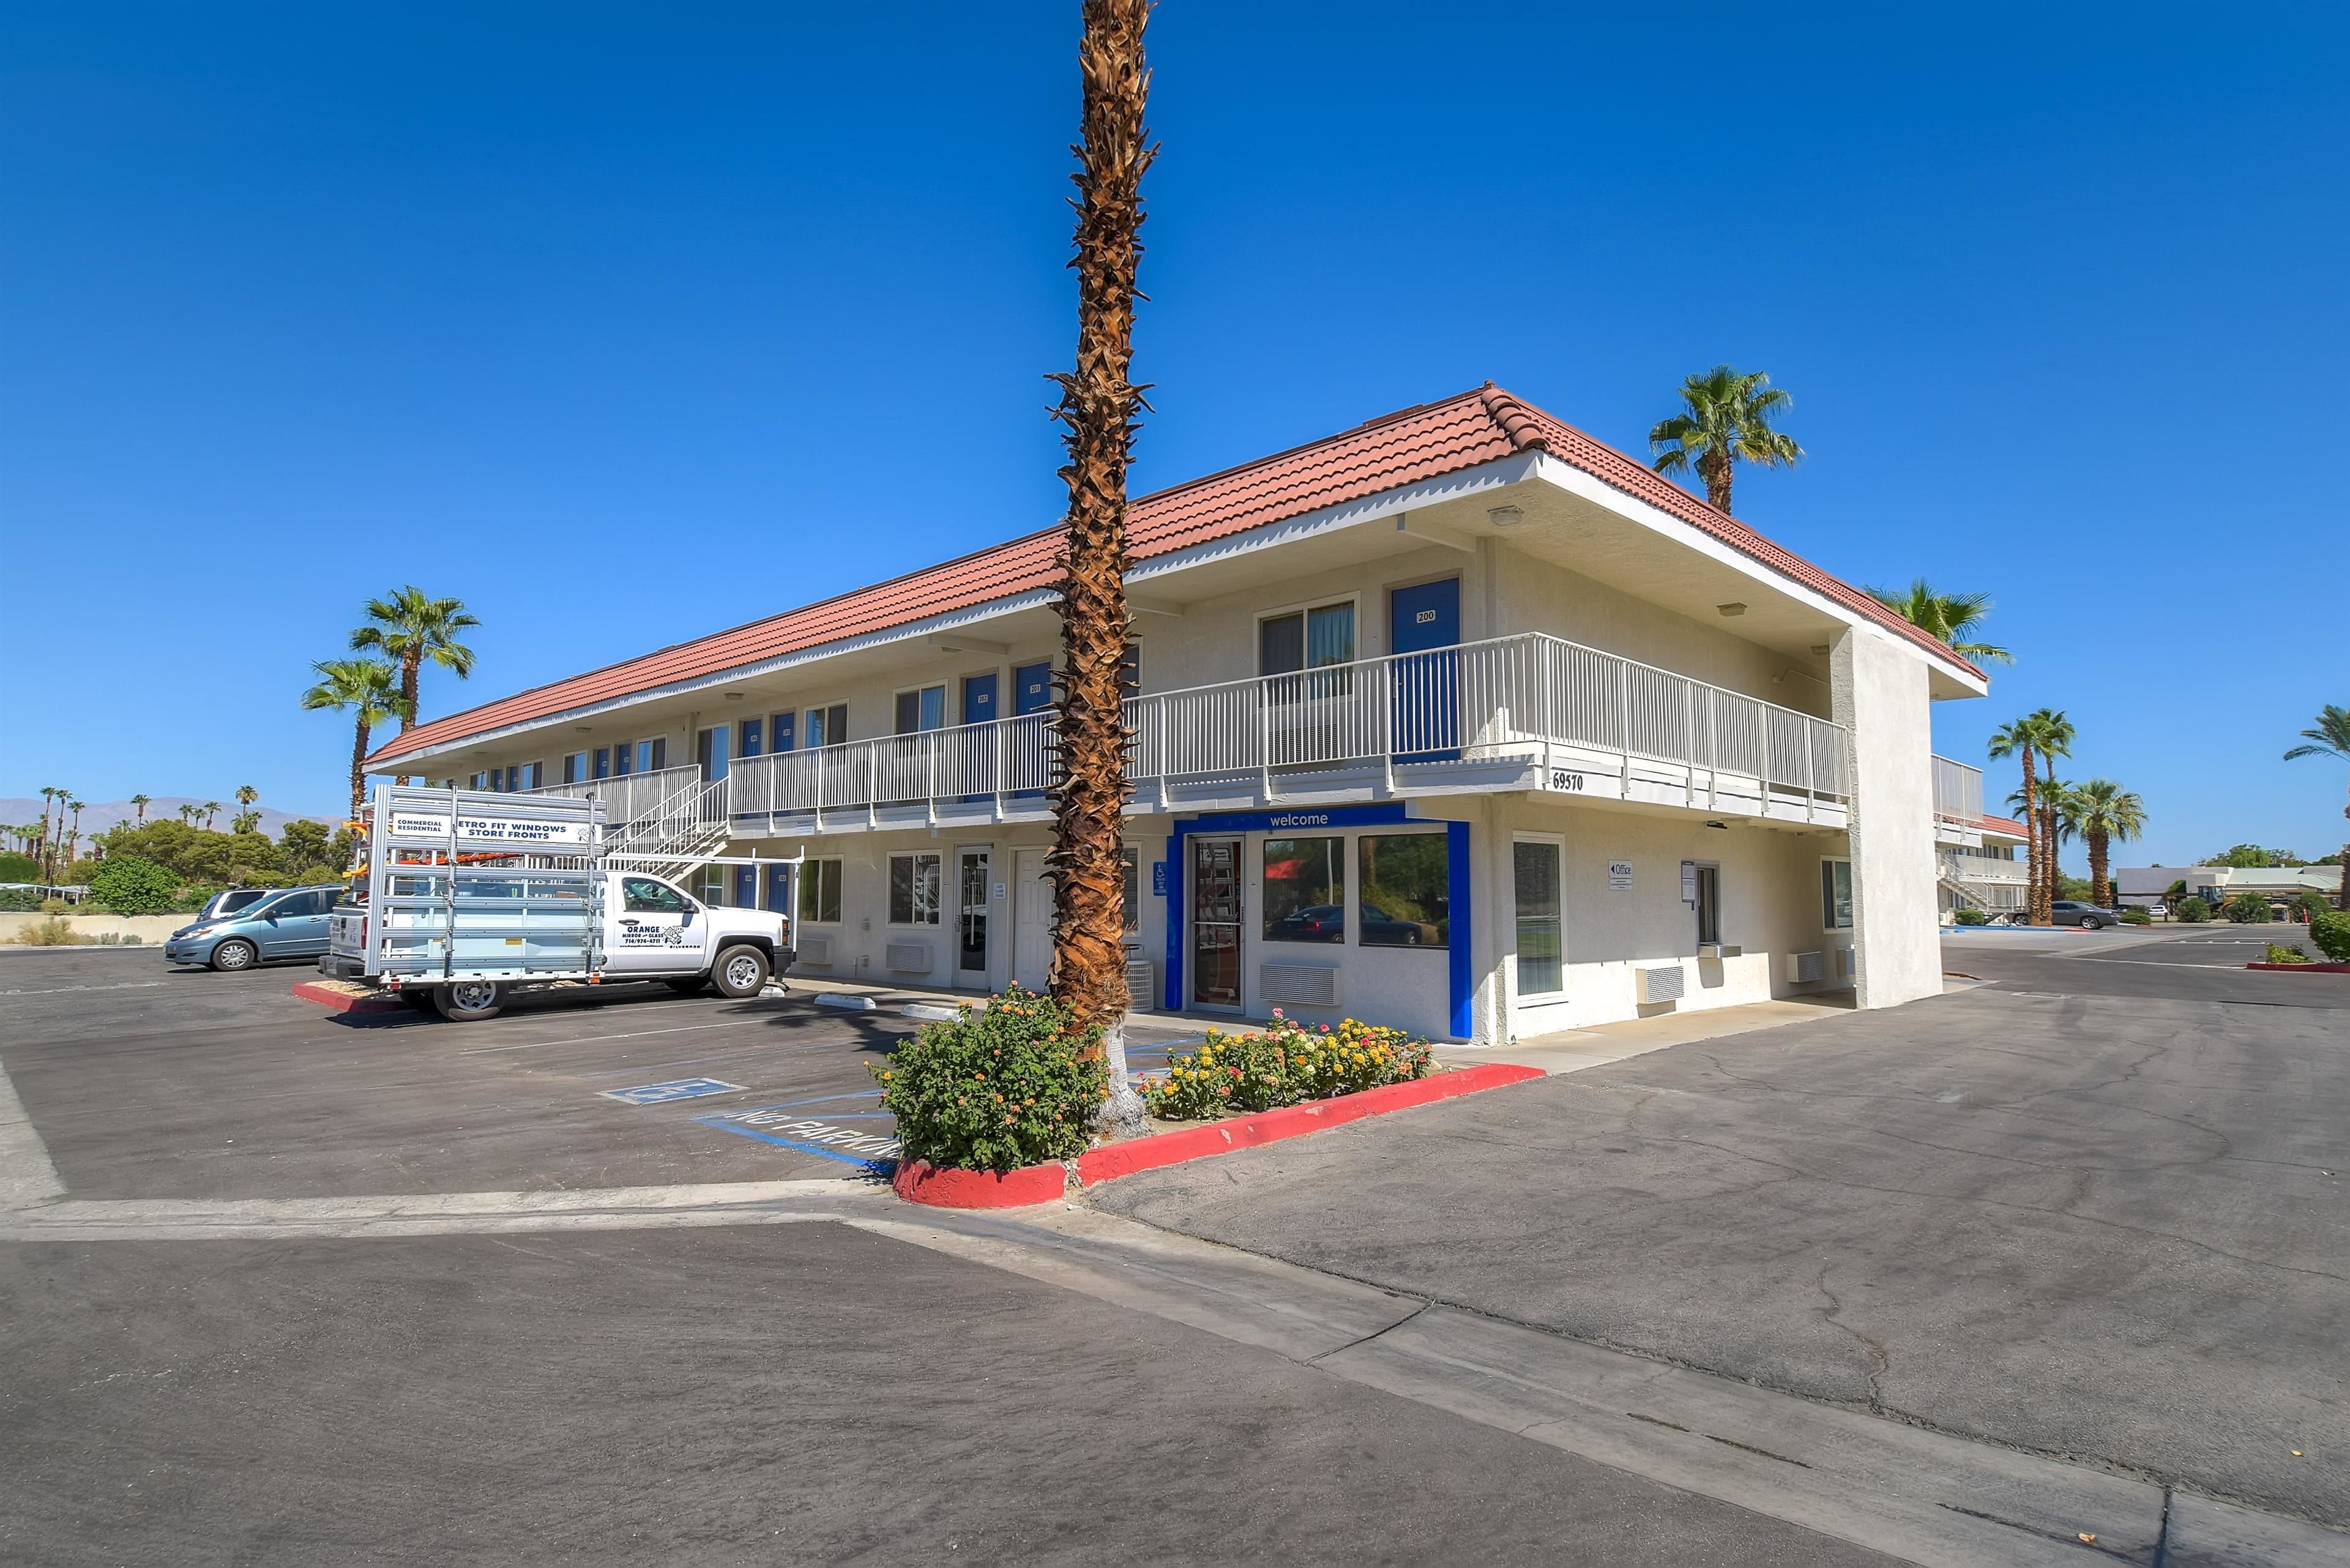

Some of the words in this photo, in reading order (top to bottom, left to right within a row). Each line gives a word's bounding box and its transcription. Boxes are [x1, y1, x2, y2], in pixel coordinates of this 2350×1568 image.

[1419, 611, 1434, 622] 200
[1553, 772, 1583, 791] 69570
[1270, 813, 1328, 826] welcome
[512, 824, 566, 832] WINDOWS
[1616, 864, 1631, 875] Office
[724, 1110, 792, 1124] NO
